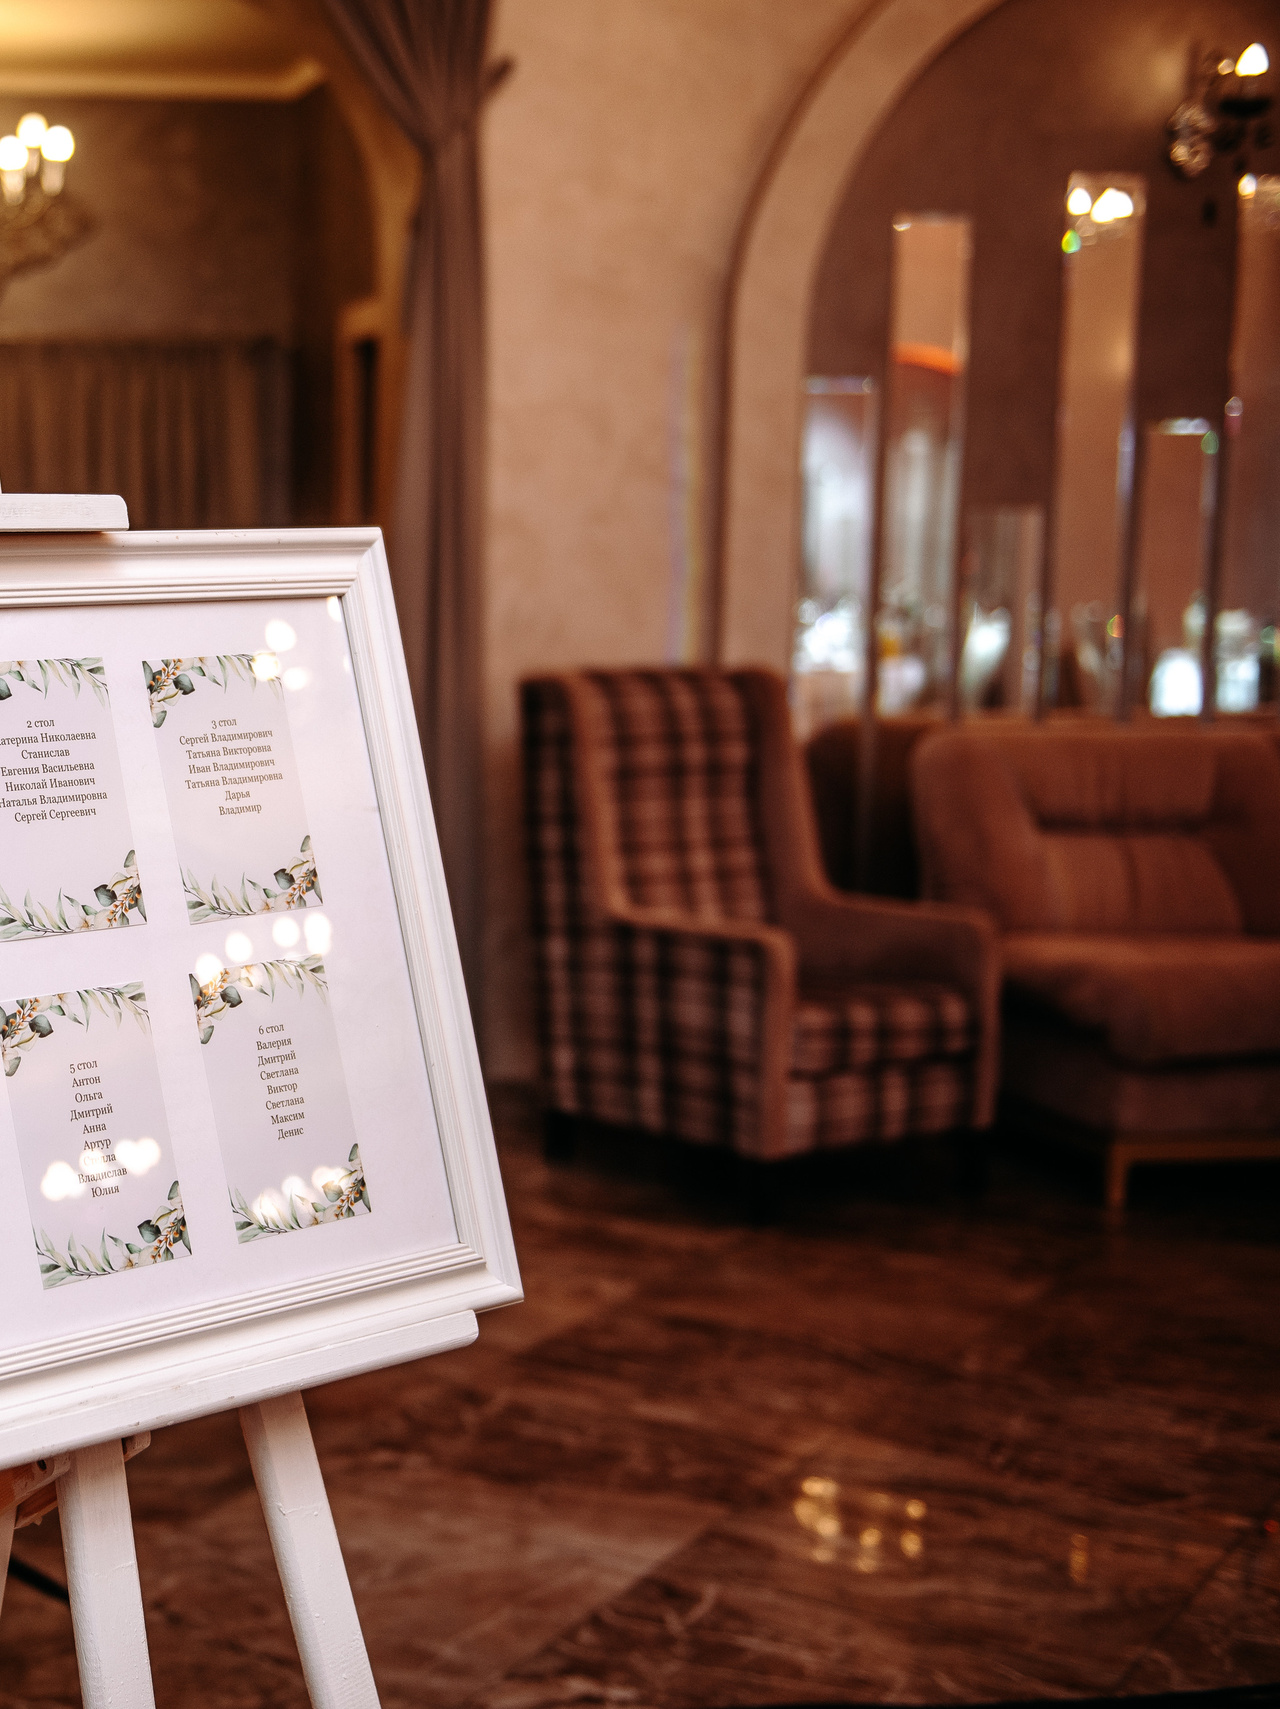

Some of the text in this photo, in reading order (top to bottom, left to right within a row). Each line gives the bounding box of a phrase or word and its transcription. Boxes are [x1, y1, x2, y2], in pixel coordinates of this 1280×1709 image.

[26, 719, 55, 728] 2 стол
[211, 719, 237, 730] 3 стол
[40, 731, 96, 743] Николаевна
[179, 730, 273, 747] Сергей Владимирович
[21, 748, 70, 759] Станислав
[186, 744, 272, 759] Татьяна Викторовна
[0, 762, 95, 777] Евгения Васильевна
[188, 758, 275, 774] Иван Владимирович
[5, 777, 96, 792] Николай Иванович
[185, 772, 283, 790] Татьяна Владимировна
[39, 792, 108, 805] Владимировна
[225, 790, 250, 802] Дарья
[14, 807, 97, 824] Сергей Сергеевич
[218, 803, 262, 816] Владимир
[258, 1024, 284, 1035] 6 стол
[256, 1037, 292, 1051] Валерия
[257, 1050, 296, 1067] Дмитрий
[69, 1060, 98, 1074] 5 стол
[260, 1066, 299, 1080] Светлана
[71, 1075, 101, 1087] Антон
[267, 1082, 298, 1095] Виктор
[75, 1091, 103, 1103] Ольга
[265, 1096, 304, 1111] Светлана
[70, 1103, 113, 1122] Дмитрий
[271, 1111, 305, 1125] Максим
[82, 1123, 107, 1134] Анна
[277, 1126, 304, 1140] Денис
[83, 1137, 112, 1152] Артур
[78, 1167, 128, 1184] Владислав
[91, 1184, 120, 1198] Юлия
